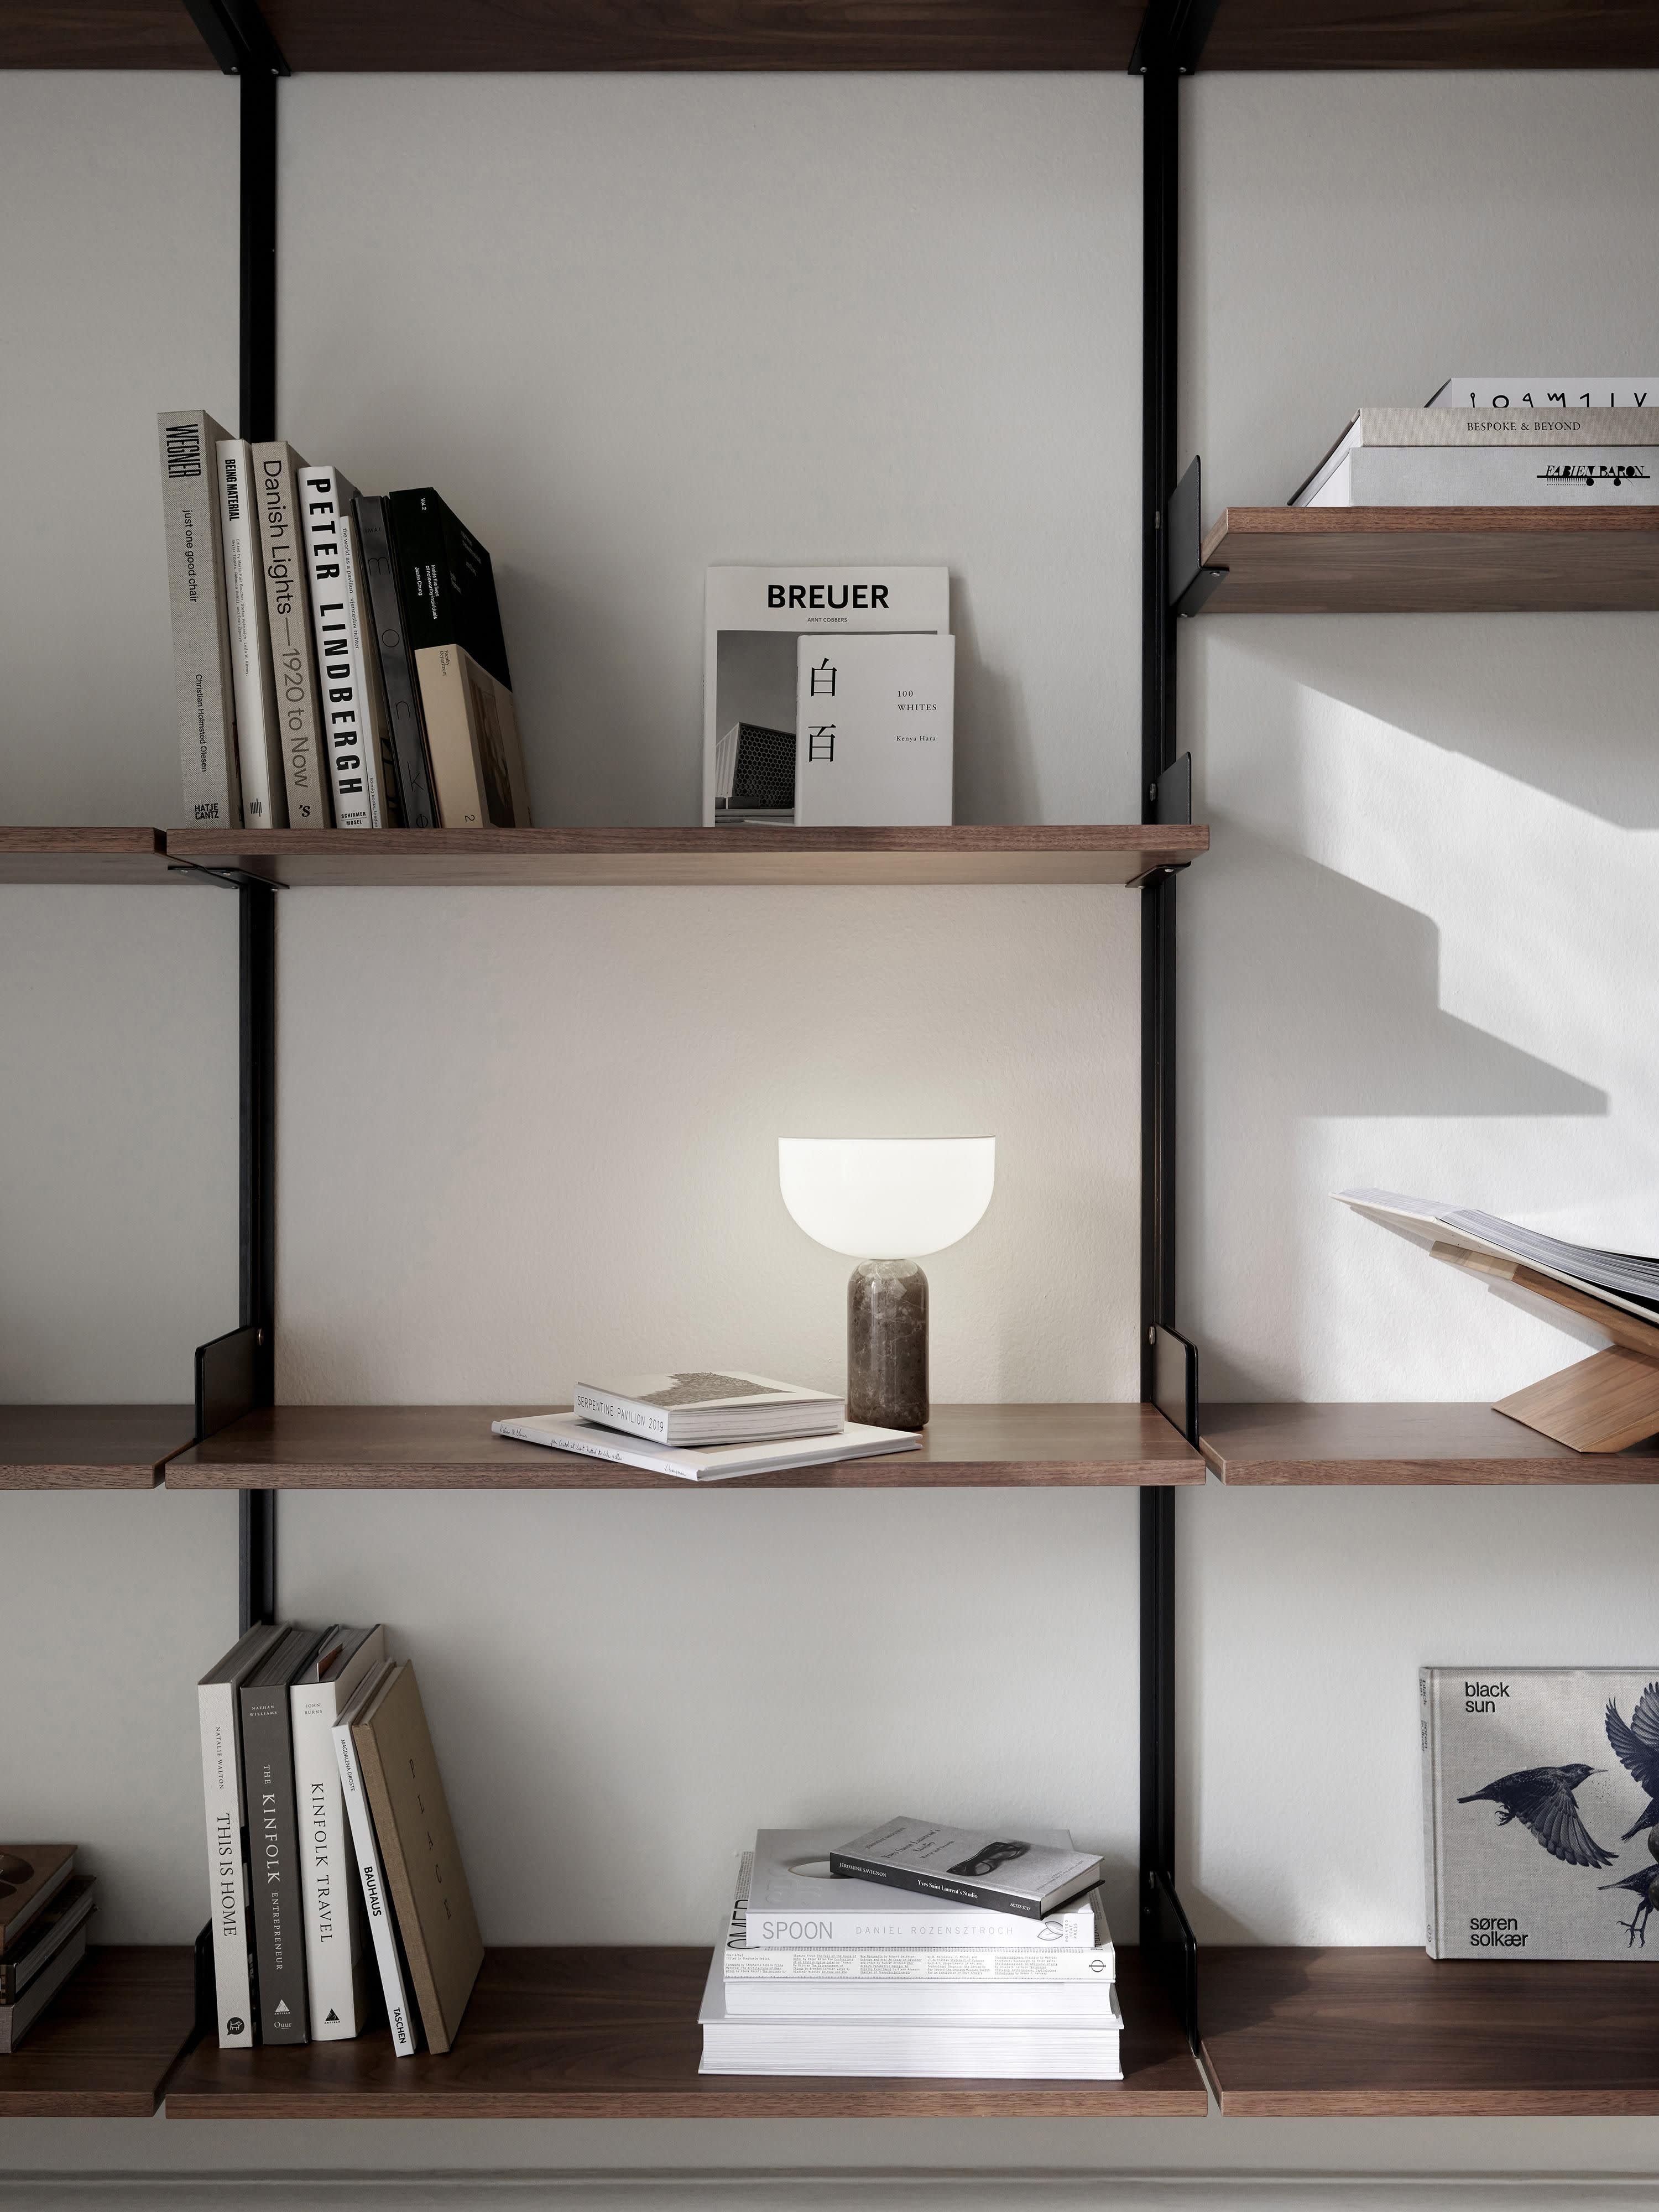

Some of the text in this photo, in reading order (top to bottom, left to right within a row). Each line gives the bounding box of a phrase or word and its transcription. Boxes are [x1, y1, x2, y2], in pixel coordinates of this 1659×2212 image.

[1467, 422, 1580, 431] BESPOKE & BEYOND
[166, 424, 201, 478] WEGNER
[1546, 466, 1645, 476] FABIEN BARON
[225, 459, 240, 521] BEING MATERIAL
[263, 461, 288, 538] Danish
[182, 509, 193, 527] just
[185, 550, 195, 576] good
[187, 578, 197, 602] chair
[768, 585, 889, 608] BREUER
[307, 478, 363, 794] PETER LINDBERGH
[195, 674, 204, 707] Christian
[199, 709, 207, 744] Holmsted
[288, 708, 304, 731] to
[291, 737, 309, 788] Now
[195, 803, 218, 812] HATJE
[195, 811, 219, 820] CANTZ
[577, 1395, 664, 1432] SERPENTINE PAVILION 2019
[1465, 1682, 1510, 1697] black
[1465, 1699, 1495, 1713] sun
[341, 1739, 356, 1791] MAGDALENA DROSTE
[217, 1813, 237, 1936] THIS IS HOME
[311, 1783, 332, 1943] KINFOLK TRAVEL
[839, 1862, 886, 1877] JÉROMINE SAVIGNON
[263, 1793, 280, 1884] KINFOLK
[272, 1892, 283, 1970] ENTREPRENEUR
[364, 1866, 382, 1917] BAUHAUS
[929, 1882, 940, 1890] Saint
[941, 1885, 962, 1895] Laurent's
[963, 1891, 978, 1899] Studio
[763, 1921, 832, 1939] SPOON
[1470, 1917, 1518, 1931] søren
[1470, 1931, 1528, 1947] solkær
[393, 2007, 406, 2044] TASCHEN
